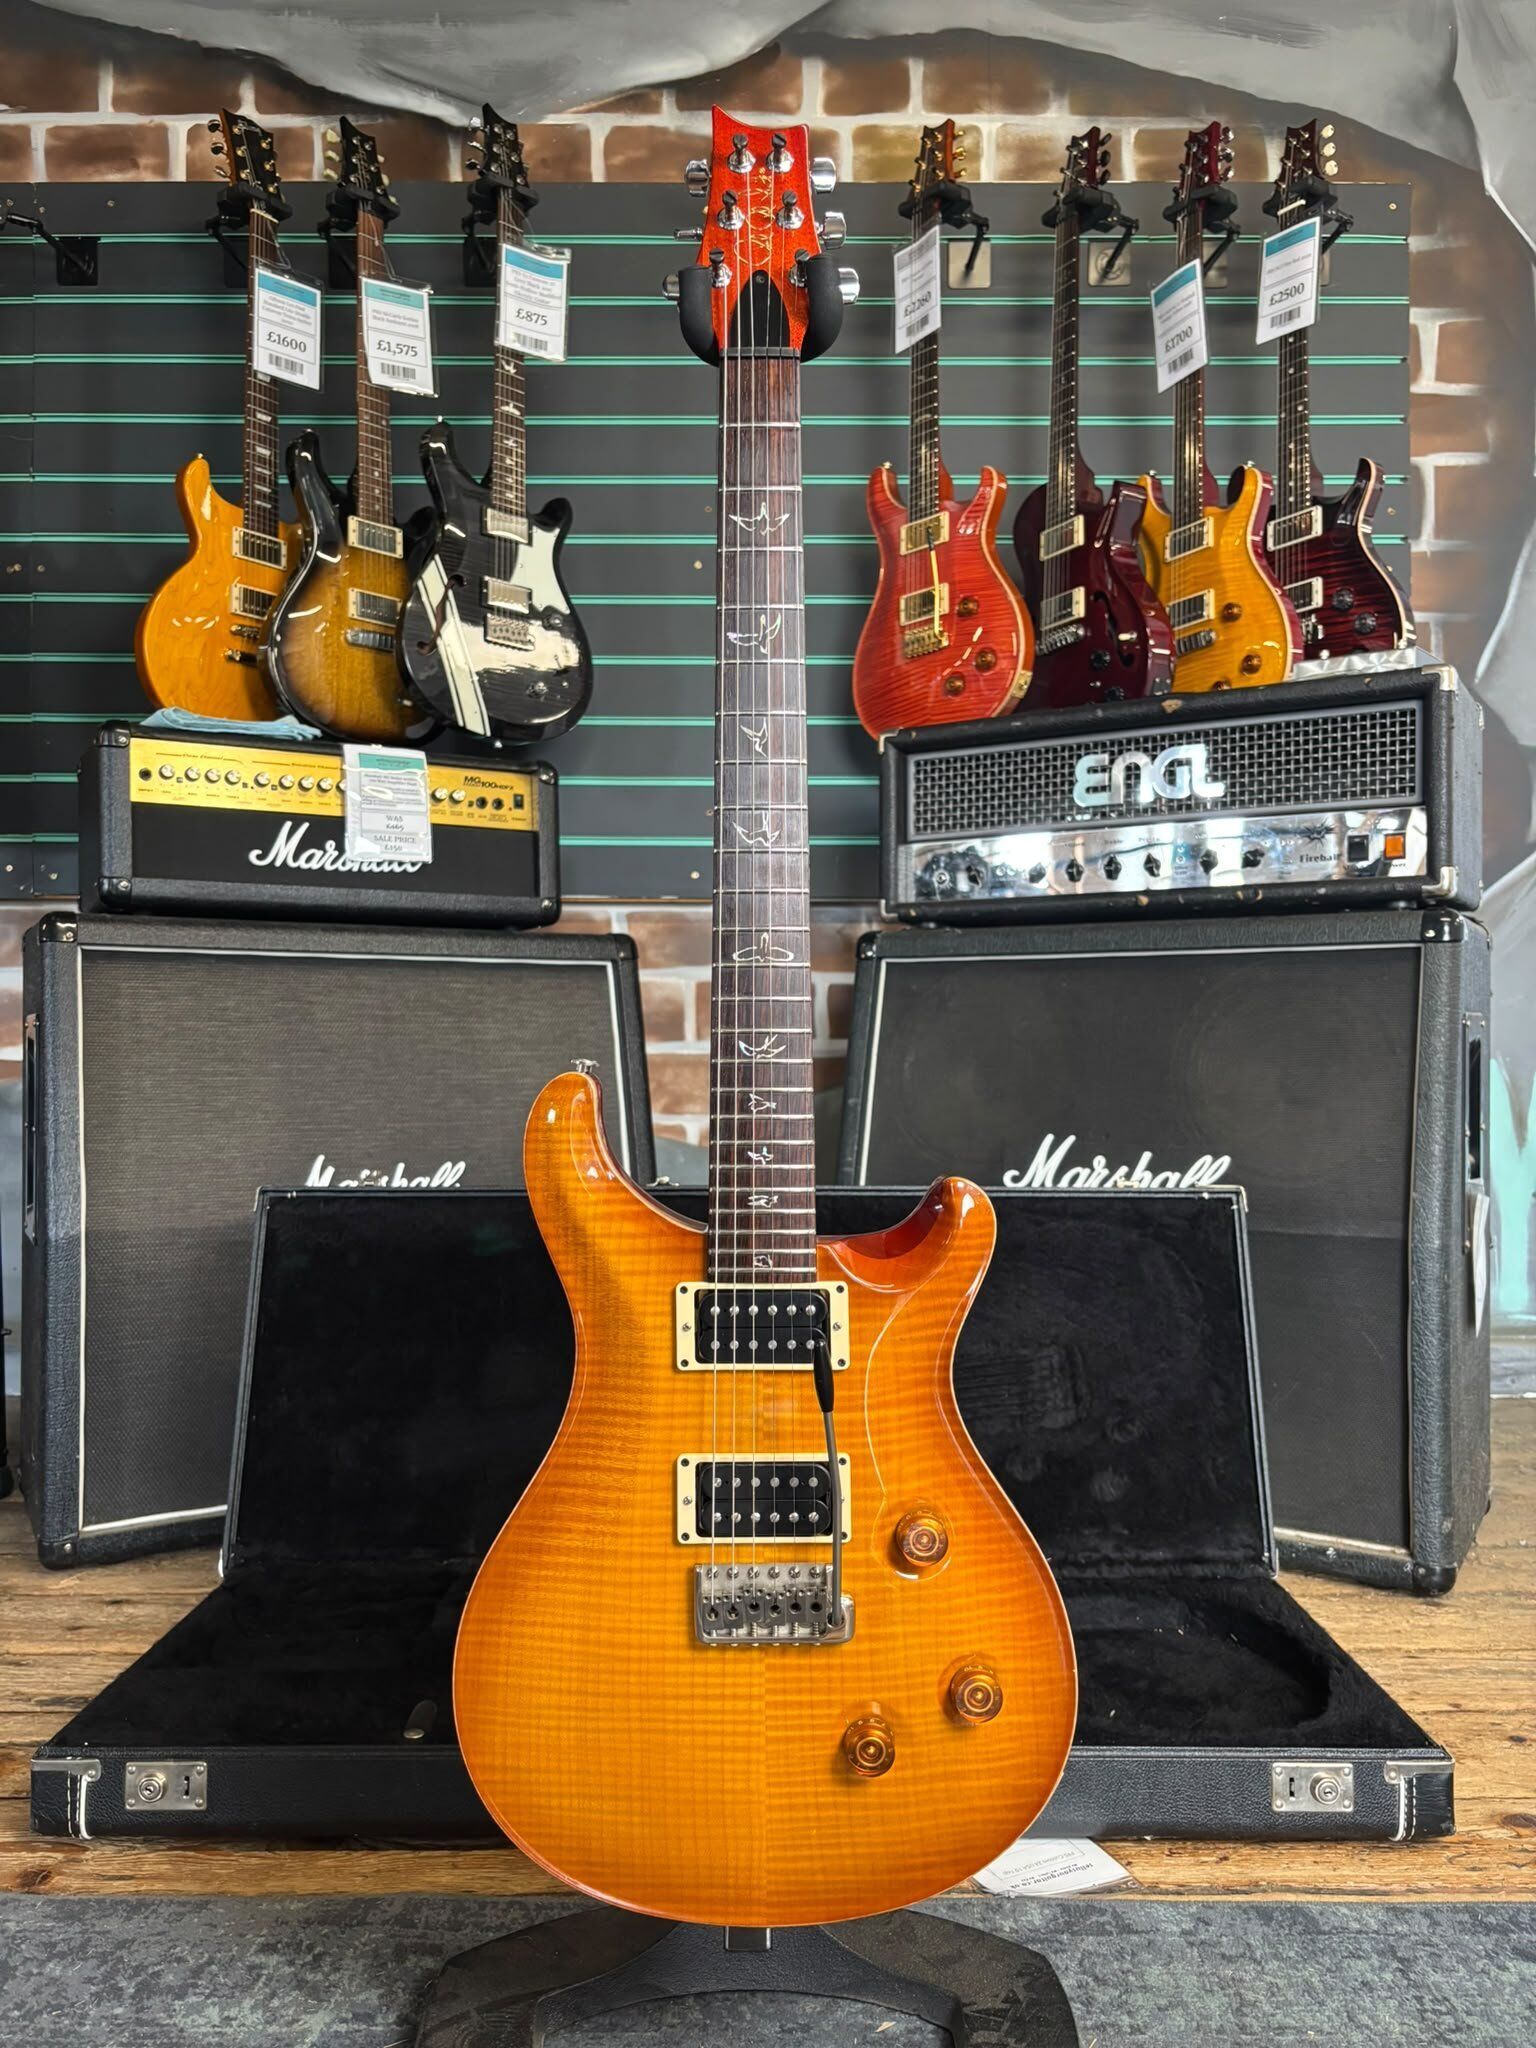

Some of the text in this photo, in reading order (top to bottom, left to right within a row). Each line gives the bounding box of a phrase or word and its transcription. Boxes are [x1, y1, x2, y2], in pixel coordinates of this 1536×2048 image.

[1269, 282, 1305, 307] £2500
[515, 308, 548, 326] £875
[266, 330, 307, 354] £1600
[376, 340, 418, 358] £1,575
[1002, 1132, 1231, 1188] Marshall
